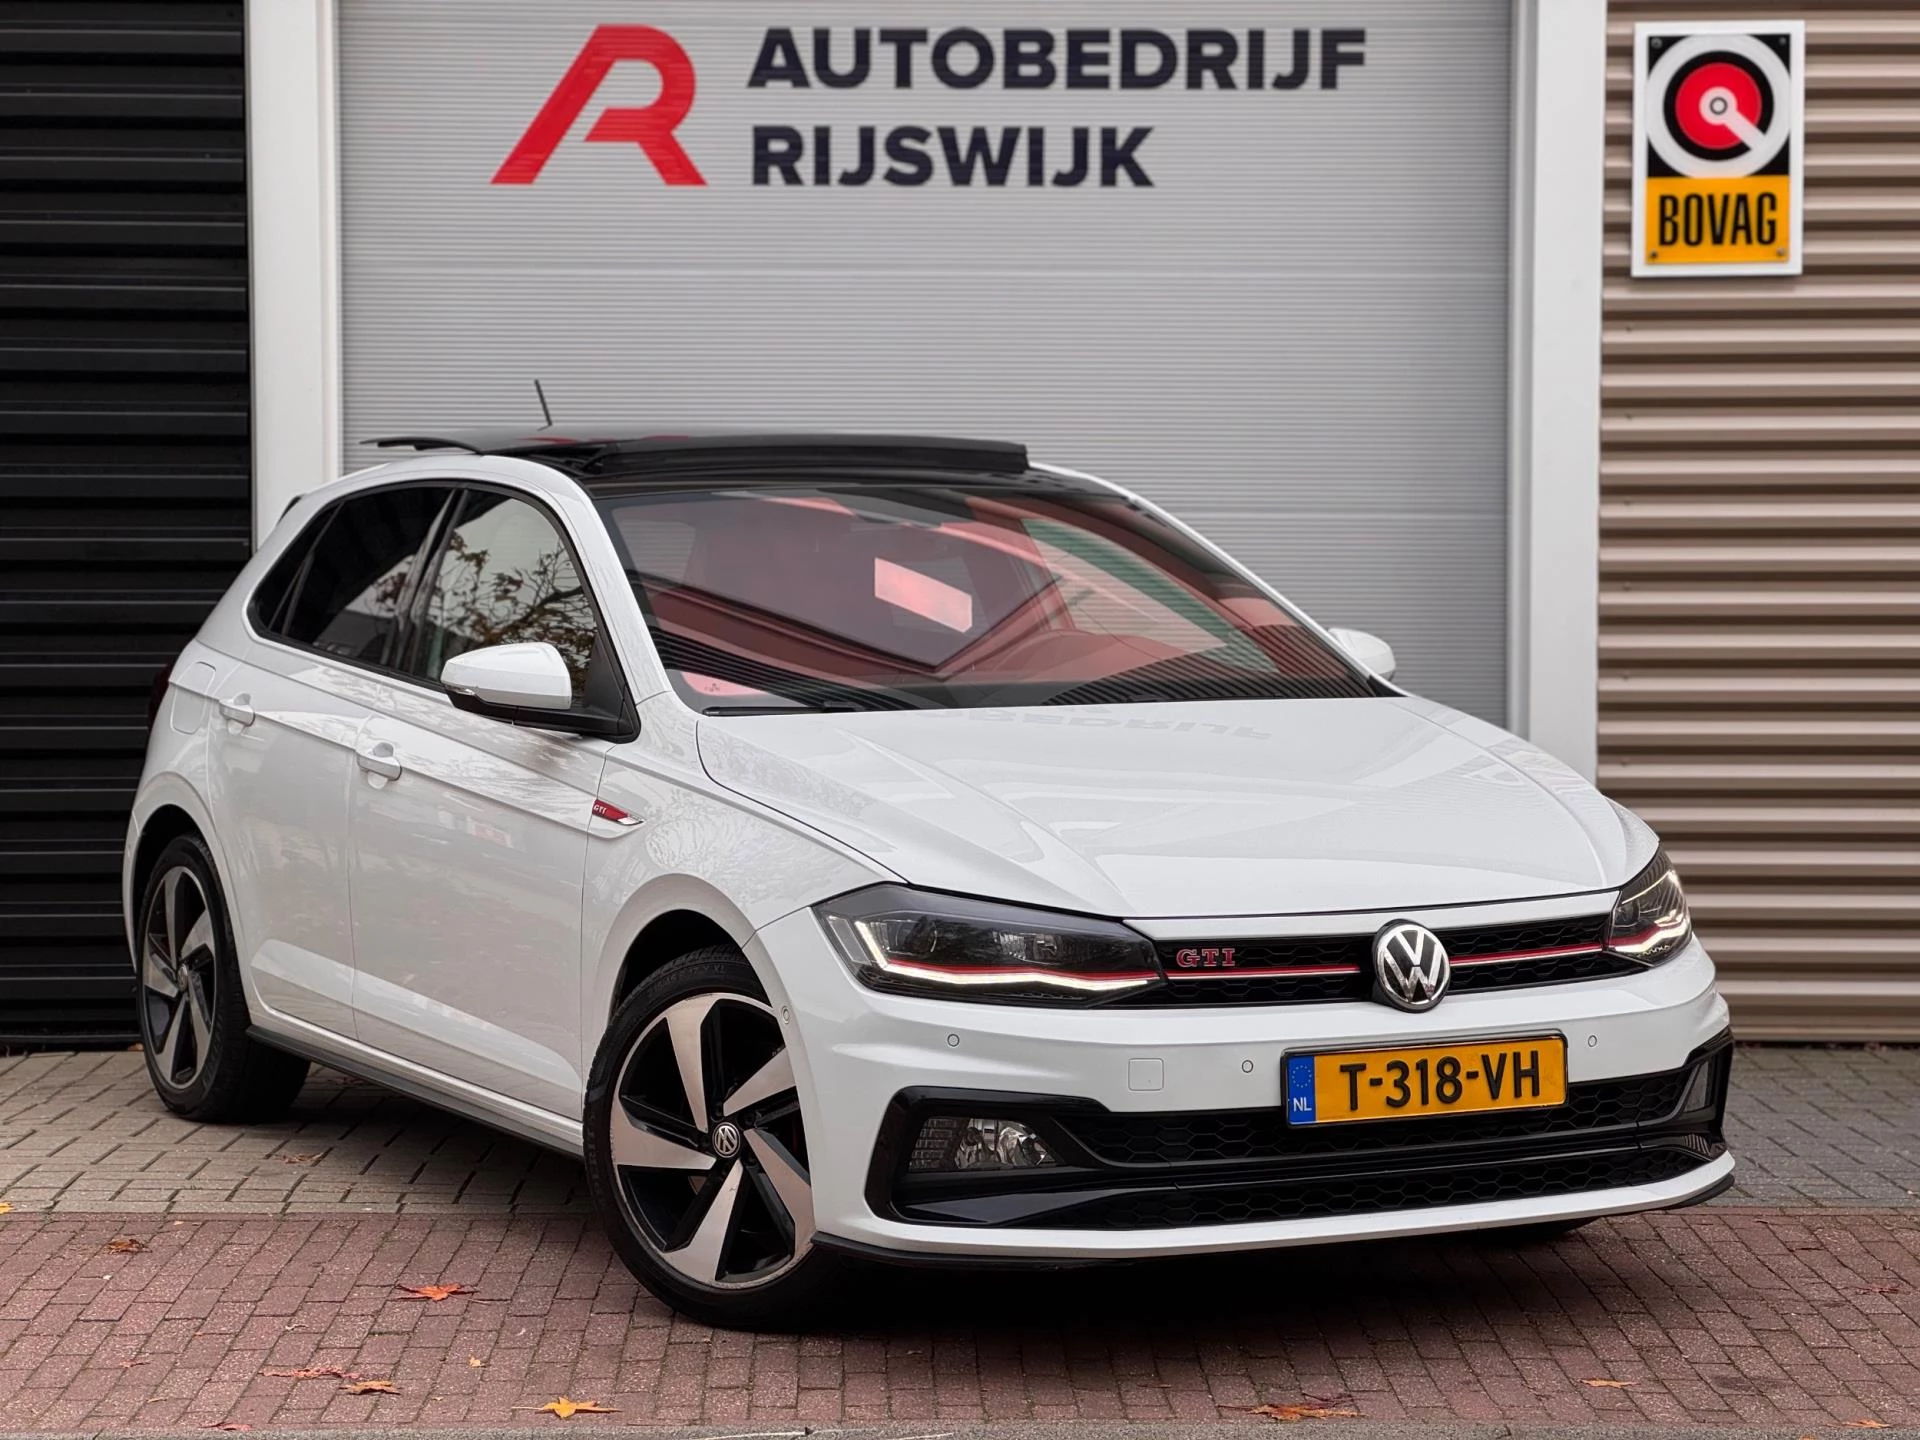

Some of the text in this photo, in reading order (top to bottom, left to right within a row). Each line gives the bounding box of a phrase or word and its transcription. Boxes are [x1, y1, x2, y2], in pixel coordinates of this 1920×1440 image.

[747, 27, 1367, 90] AUTOBEDRIJF
[752, 125, 1154, 188] RIJSWIJK
[1658, 192, 1777, 247] BOVAG
[593, 804, 607, 815] GTI
[1176, 948, 1236, 967] GTI
[1293, 1096, 1312, 1112] NL
[1339, 1050, 1541, 1112] T-318-VH
